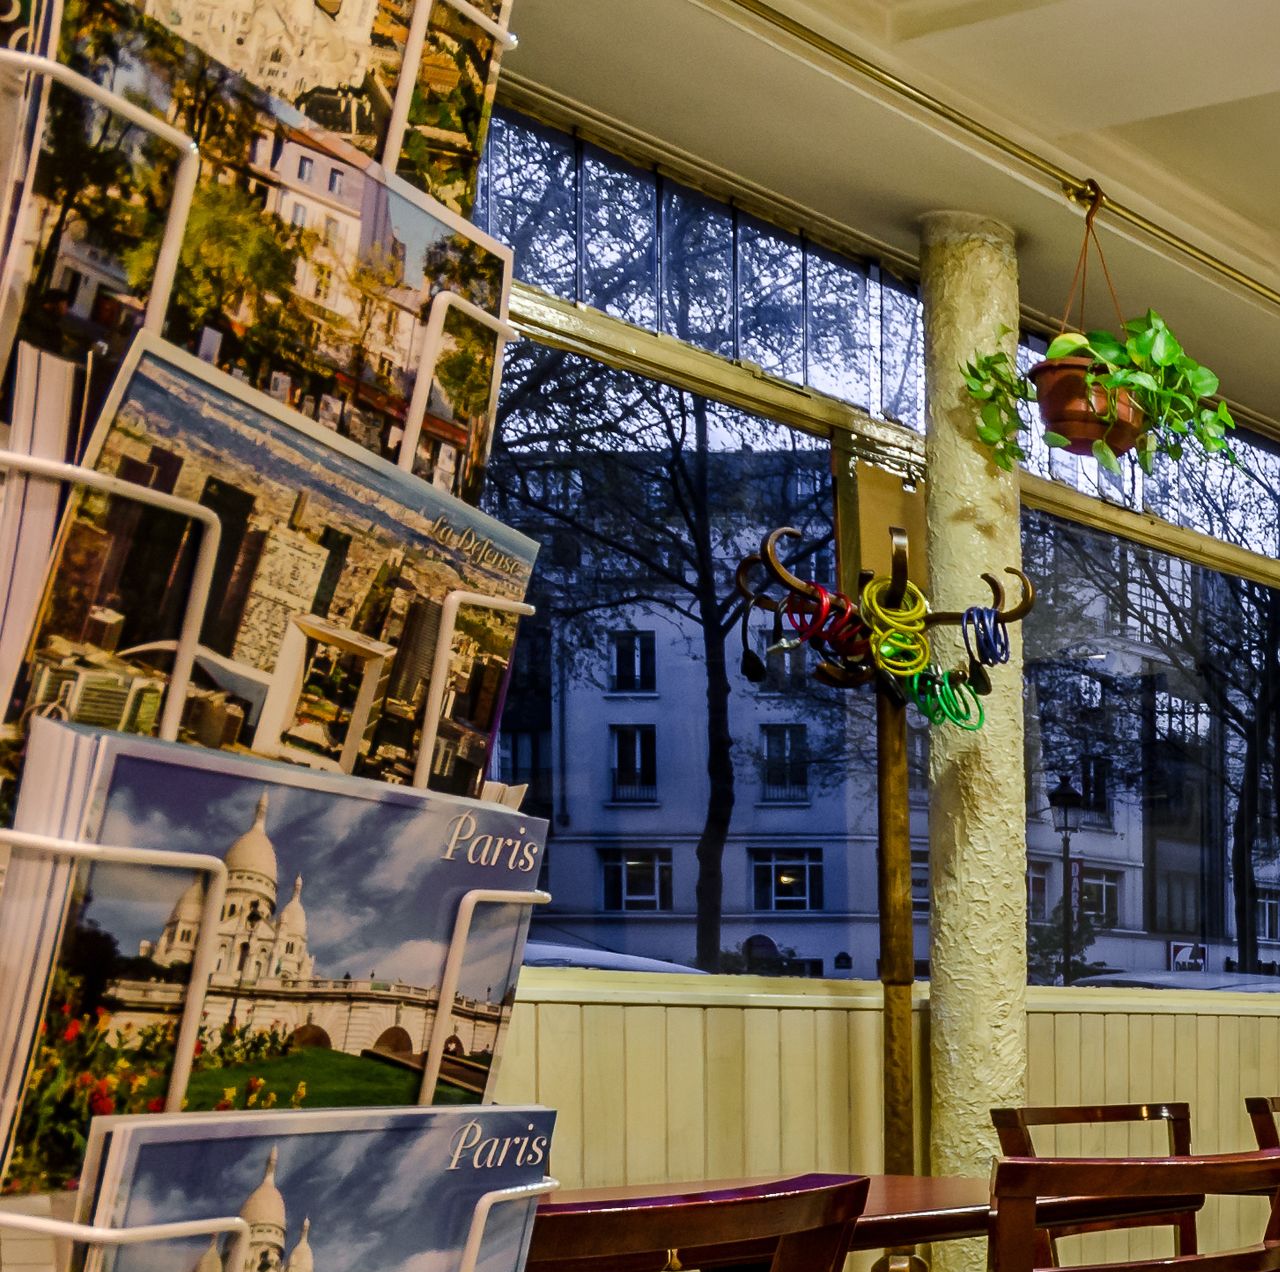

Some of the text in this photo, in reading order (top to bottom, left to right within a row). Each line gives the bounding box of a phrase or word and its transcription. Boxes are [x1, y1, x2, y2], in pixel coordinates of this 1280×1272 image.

[440, 808, 538, 873] Paris
[1175, 961, 1204, 971] DARY
[445, 1118, 548, 1171] Paris
